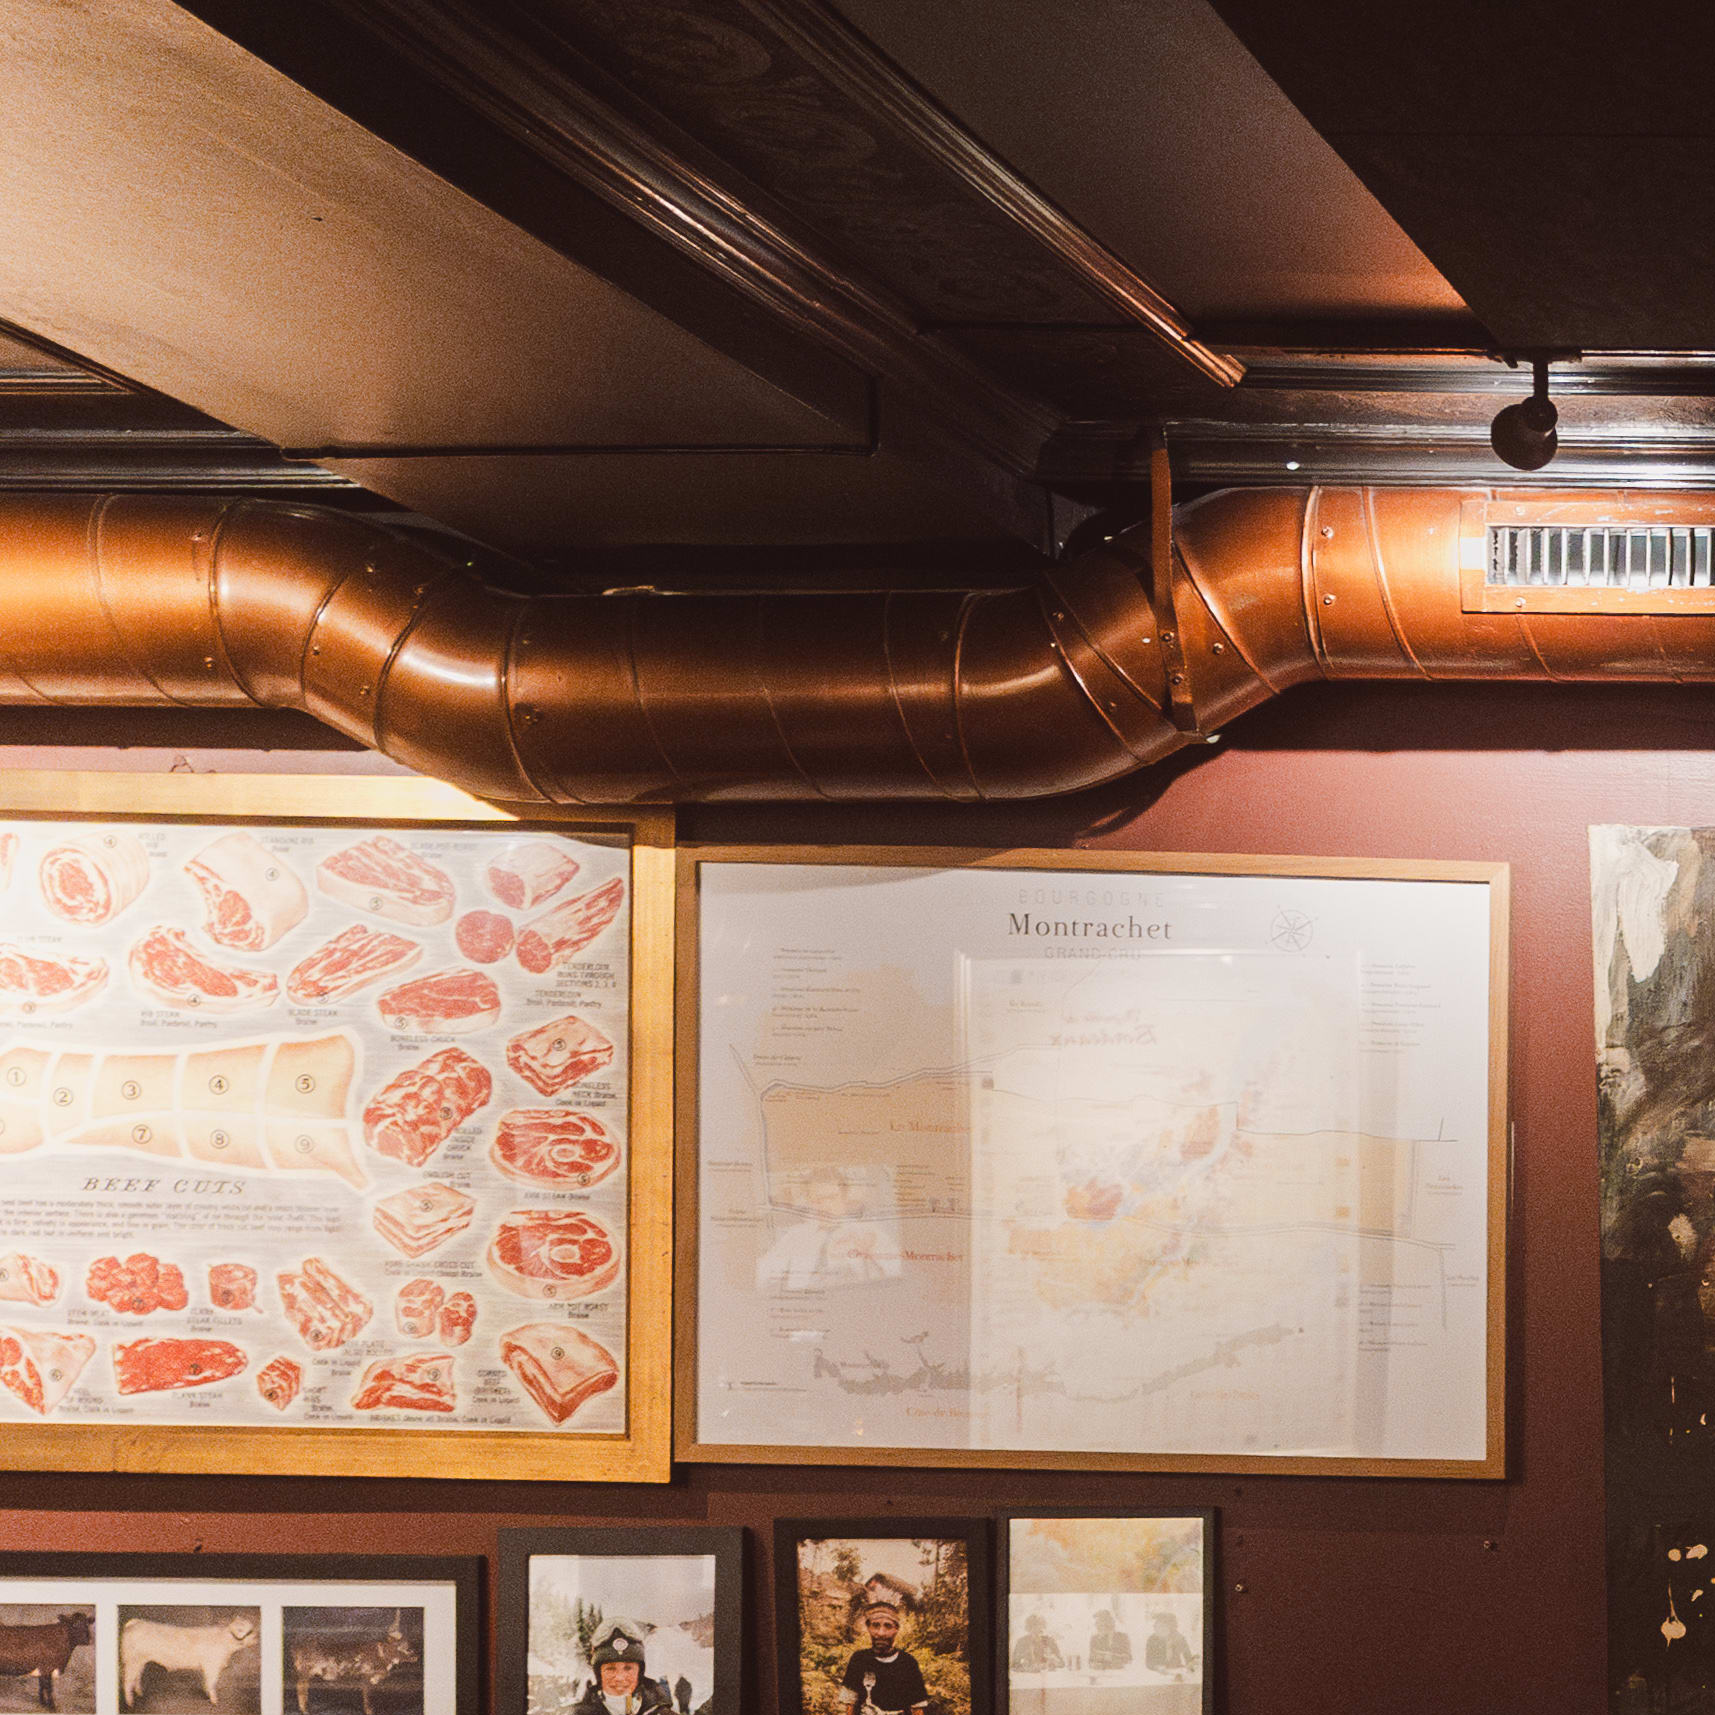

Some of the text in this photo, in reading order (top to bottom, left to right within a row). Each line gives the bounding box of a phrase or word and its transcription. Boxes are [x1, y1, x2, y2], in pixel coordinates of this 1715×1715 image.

[1018, 888, 1164, 908] BOURGOGNE
[1008, 912, 1173, 940] Montrachet
[82, 1177, 247, 1196] BEEF CUTS
